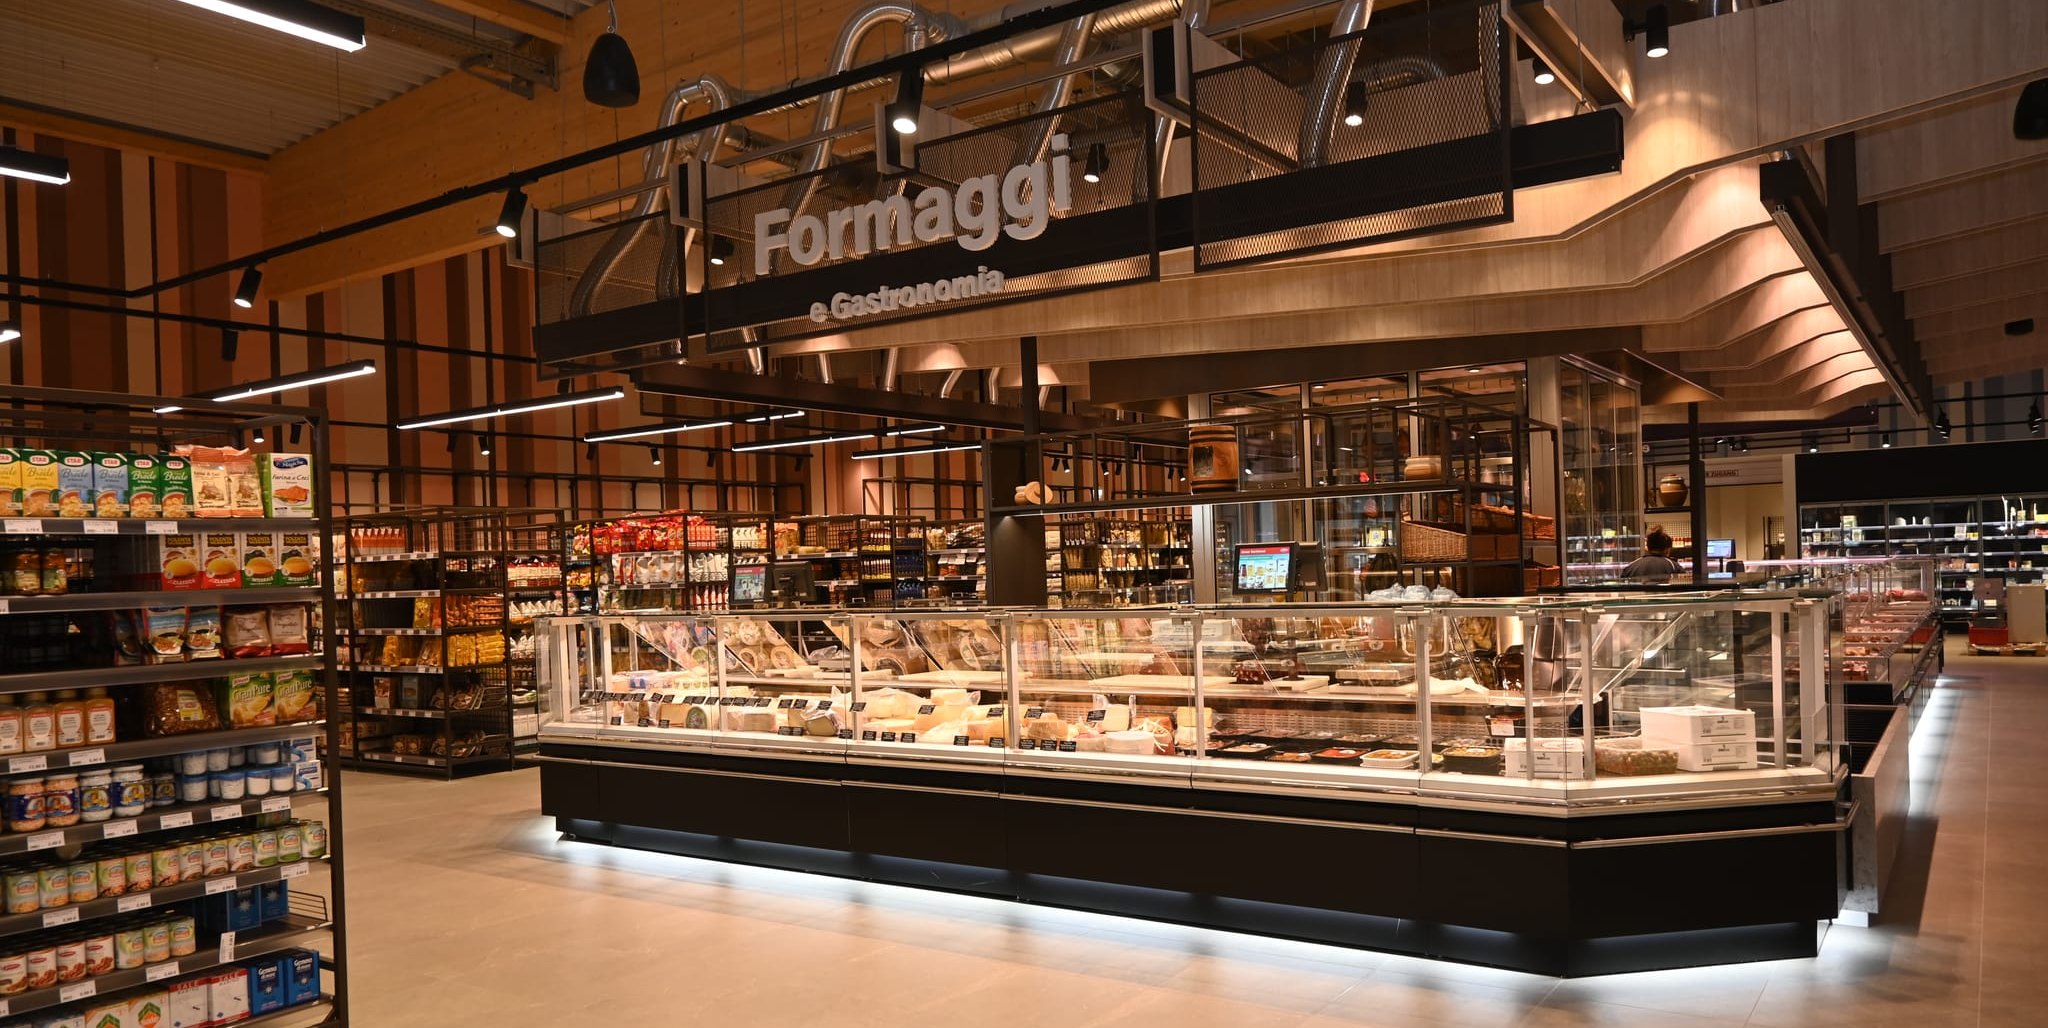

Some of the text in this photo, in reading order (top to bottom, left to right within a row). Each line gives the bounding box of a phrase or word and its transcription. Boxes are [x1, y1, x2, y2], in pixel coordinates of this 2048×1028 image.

[754, 132, 1072, 276] Formaggi
[809, 265, 1005, 323] e Gastronomia
[176, 980, 198, 989] SALE
[219, 972, 238, 981] SALE
